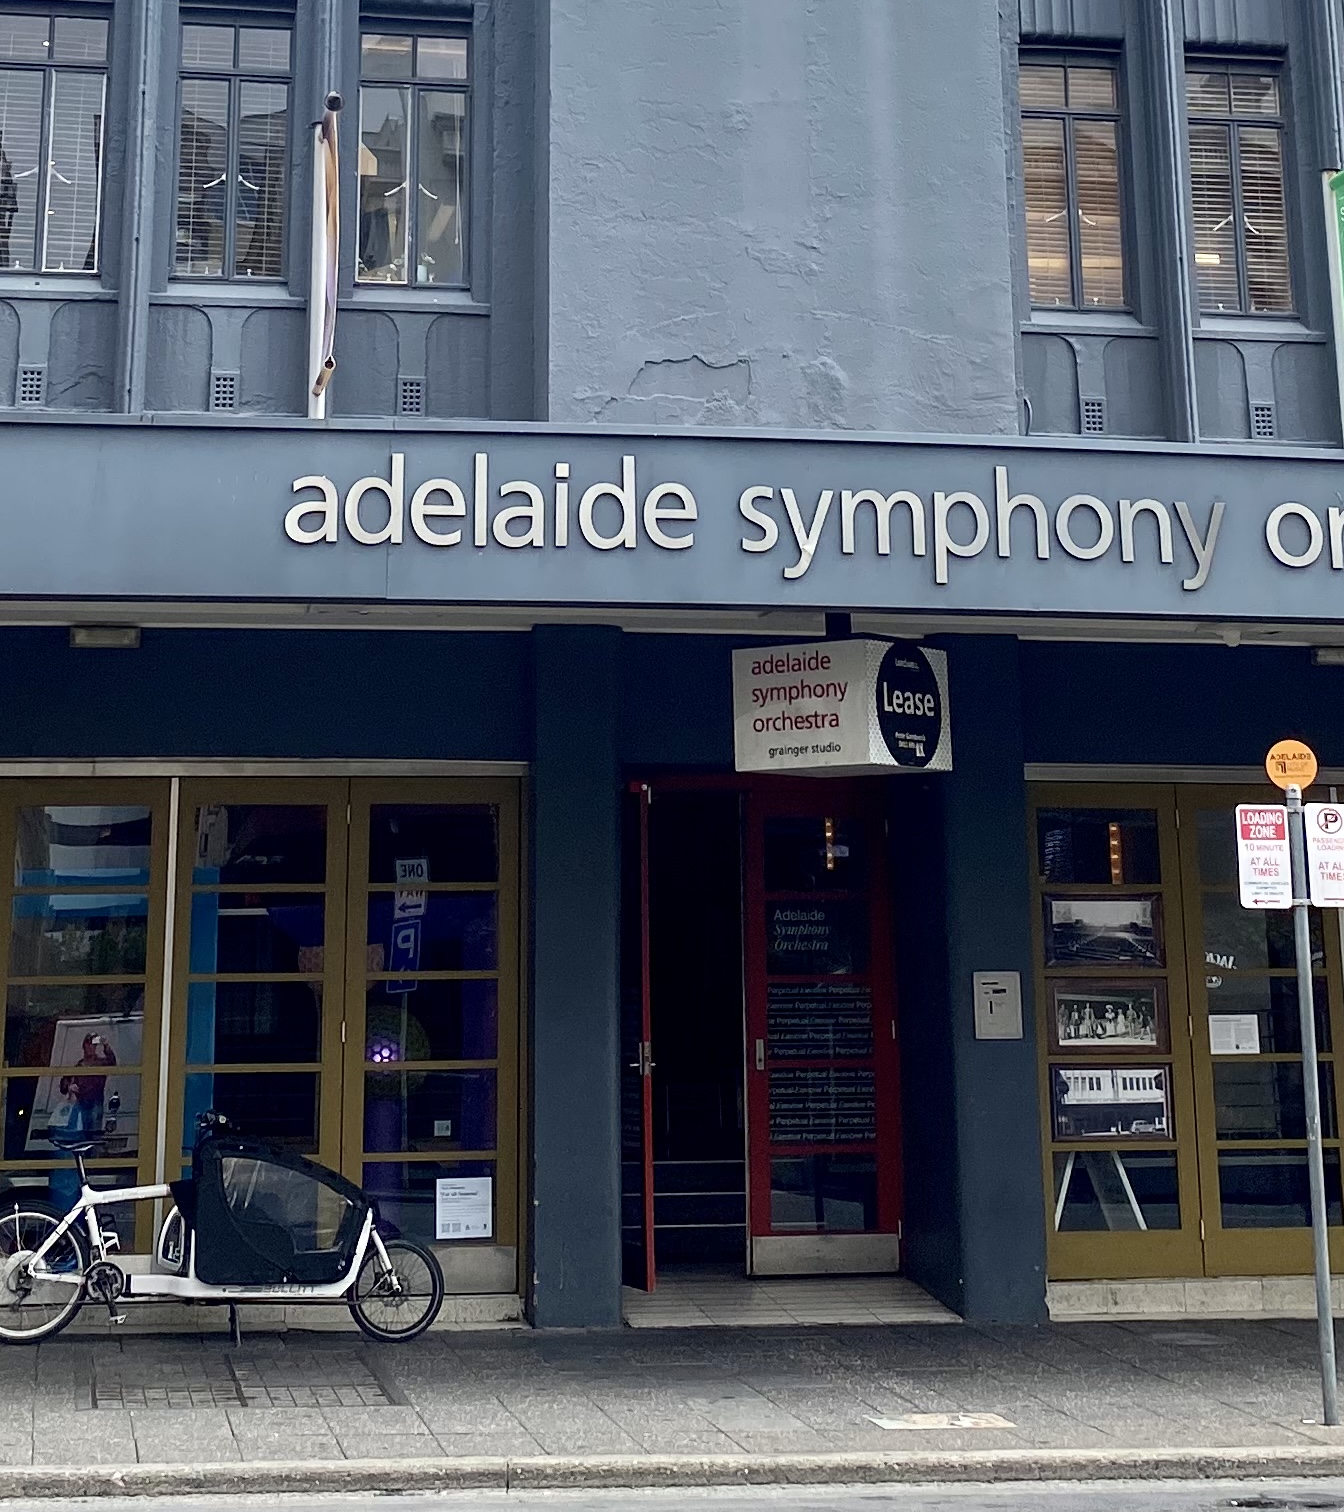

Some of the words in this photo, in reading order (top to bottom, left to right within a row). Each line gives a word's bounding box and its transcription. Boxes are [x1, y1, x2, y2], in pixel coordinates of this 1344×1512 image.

[283, 452, 698, 550] adelaide
[739, 465, 1226, 592] symphony
[751, 650, 831, 675] adelaide
[751, 679, 848, 707] symphony
[883, 681, 934, 717] Lease
[752, 710, 840, 732] orchestra
[768, 744, 808, 758] grainger
[811, 741, 841, 753] studio
[1241, 811, 1282, 824] LOADING
[1324, 813, 1338, 829] P
[1249, 825, 1276, 838] ZONE
[1244, 843, 1254, 851] 10
[1250, 857, 1260, 865] AT
[1263, 857, 1279, 865] ALL
[1318, 862, 1329, 870] AT
[1253, 868, 1279, 876] TIMES
[774, 909, 825, 920] Adelaide
[774, 938, 828, 950] Orchestra
